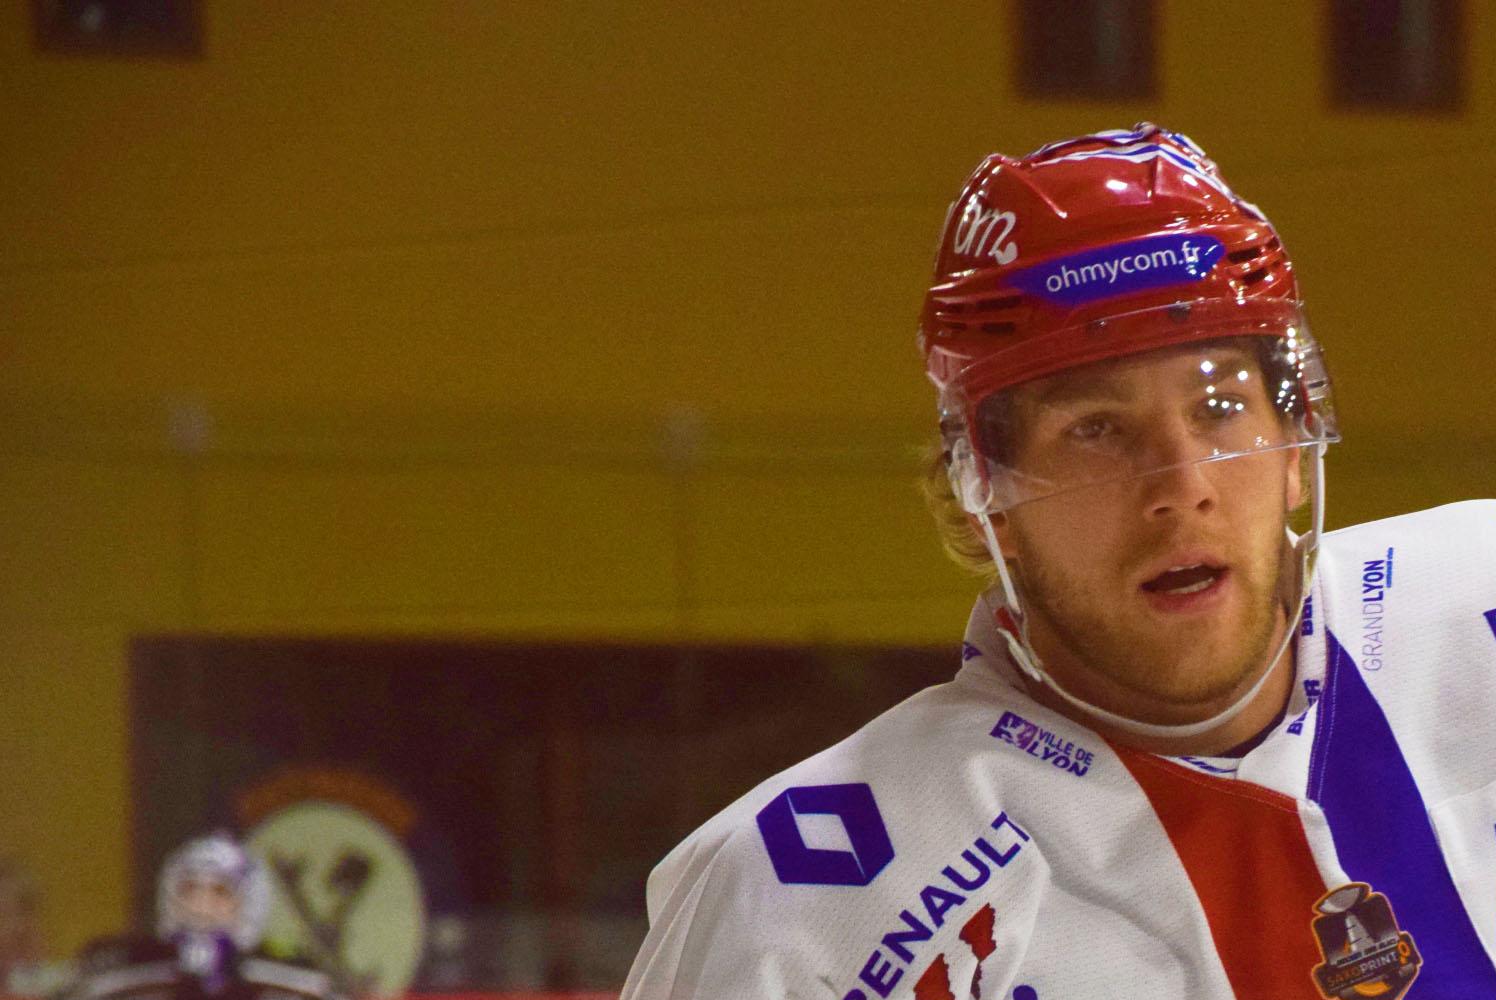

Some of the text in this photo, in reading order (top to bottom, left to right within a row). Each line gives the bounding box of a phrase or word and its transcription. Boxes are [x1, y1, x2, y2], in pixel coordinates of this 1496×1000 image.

[1045, 240, 1201, 293] ohmycom.fr
[1026, 741, 1089, 777] LYON
[1039, 728, 1095, 766] VILLE DE
